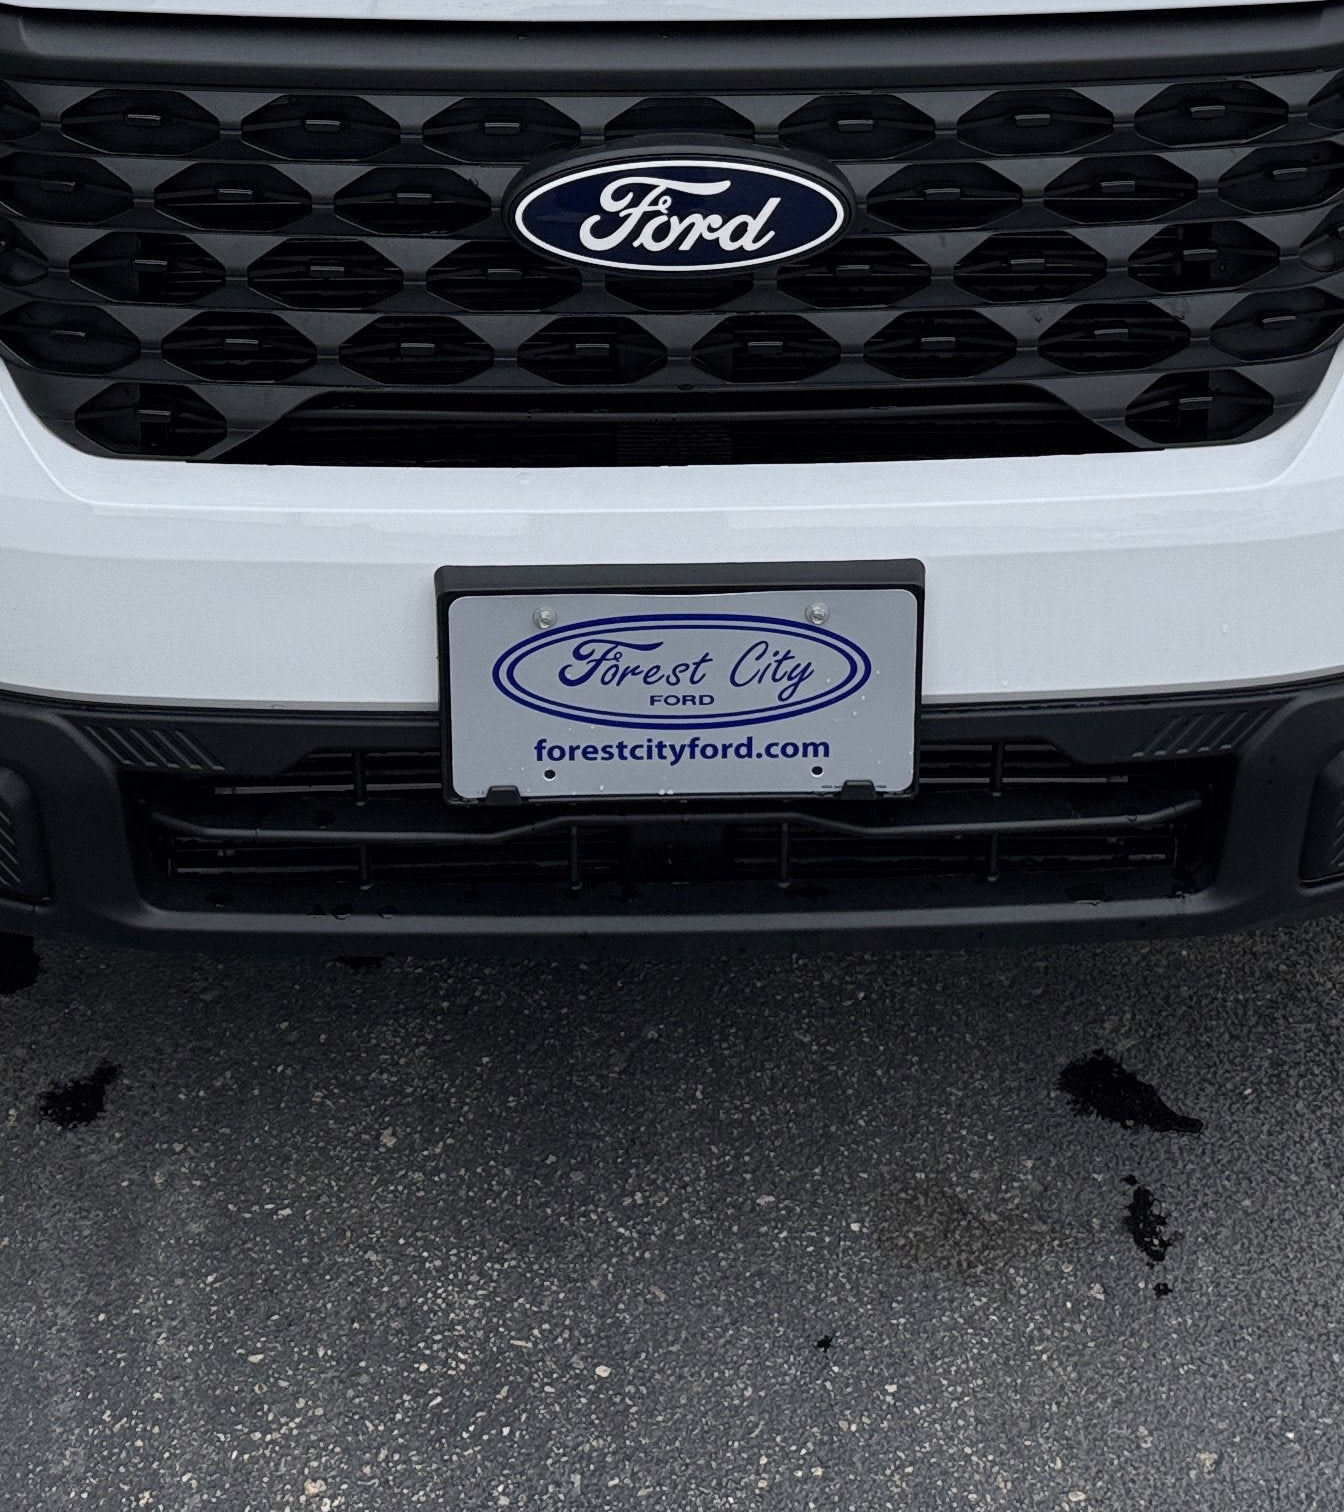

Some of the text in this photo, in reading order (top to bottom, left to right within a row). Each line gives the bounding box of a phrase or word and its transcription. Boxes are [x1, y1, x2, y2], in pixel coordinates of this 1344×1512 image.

[578, 176, 782, 252] Ford
[558, 638, 816, 702] Forest City
[649, 694, 715, 706] FORD
[533, 736, 831, 766] forestcityford.com
